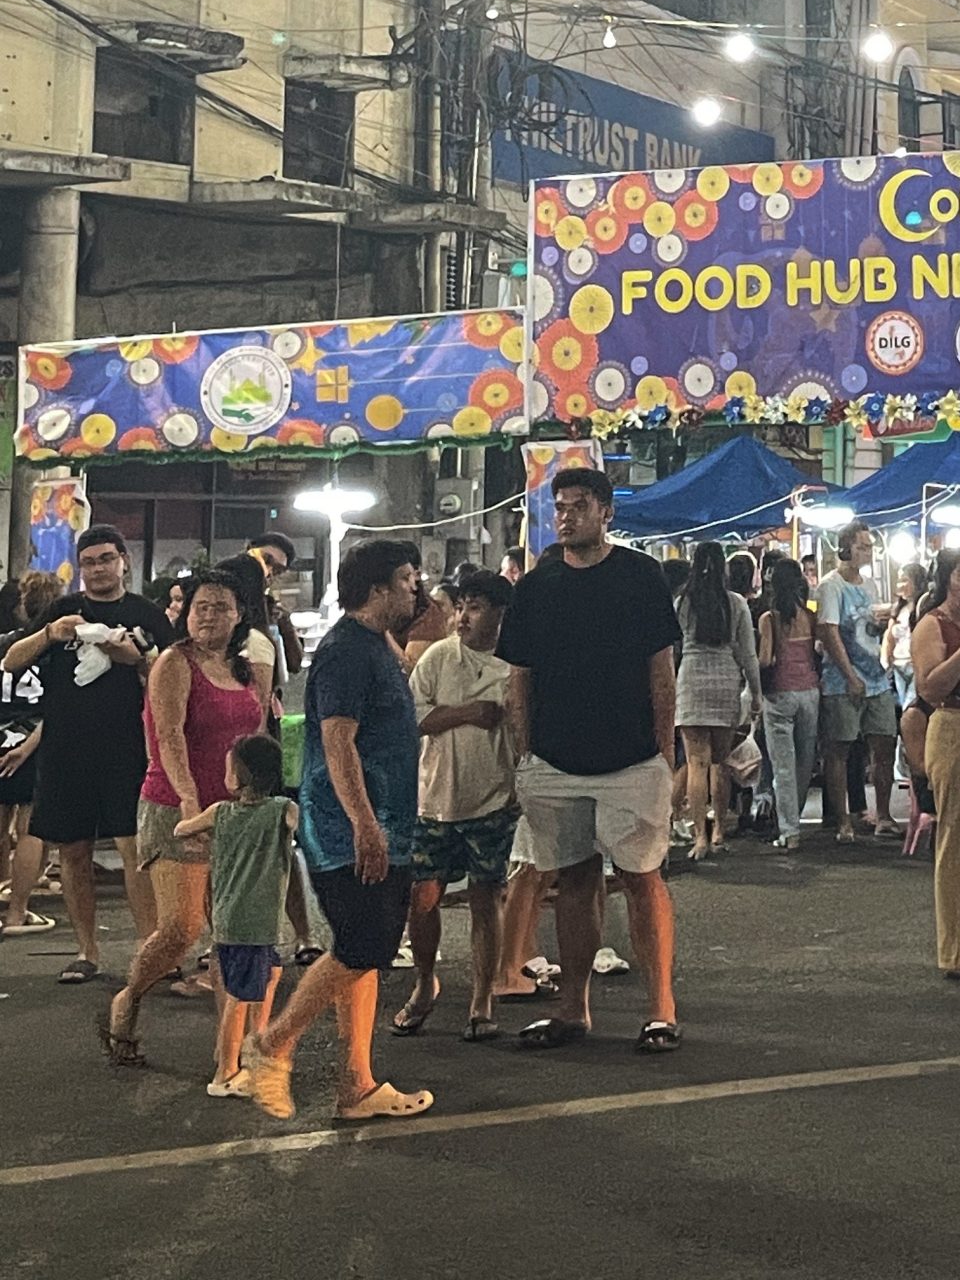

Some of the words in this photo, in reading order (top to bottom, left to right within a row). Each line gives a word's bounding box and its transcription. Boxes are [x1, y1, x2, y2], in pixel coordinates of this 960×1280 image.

[620, 261, 772, 315] FOOD
[787, 254, 897, 304] HUB
[878, 335, 911, 349] DILG
